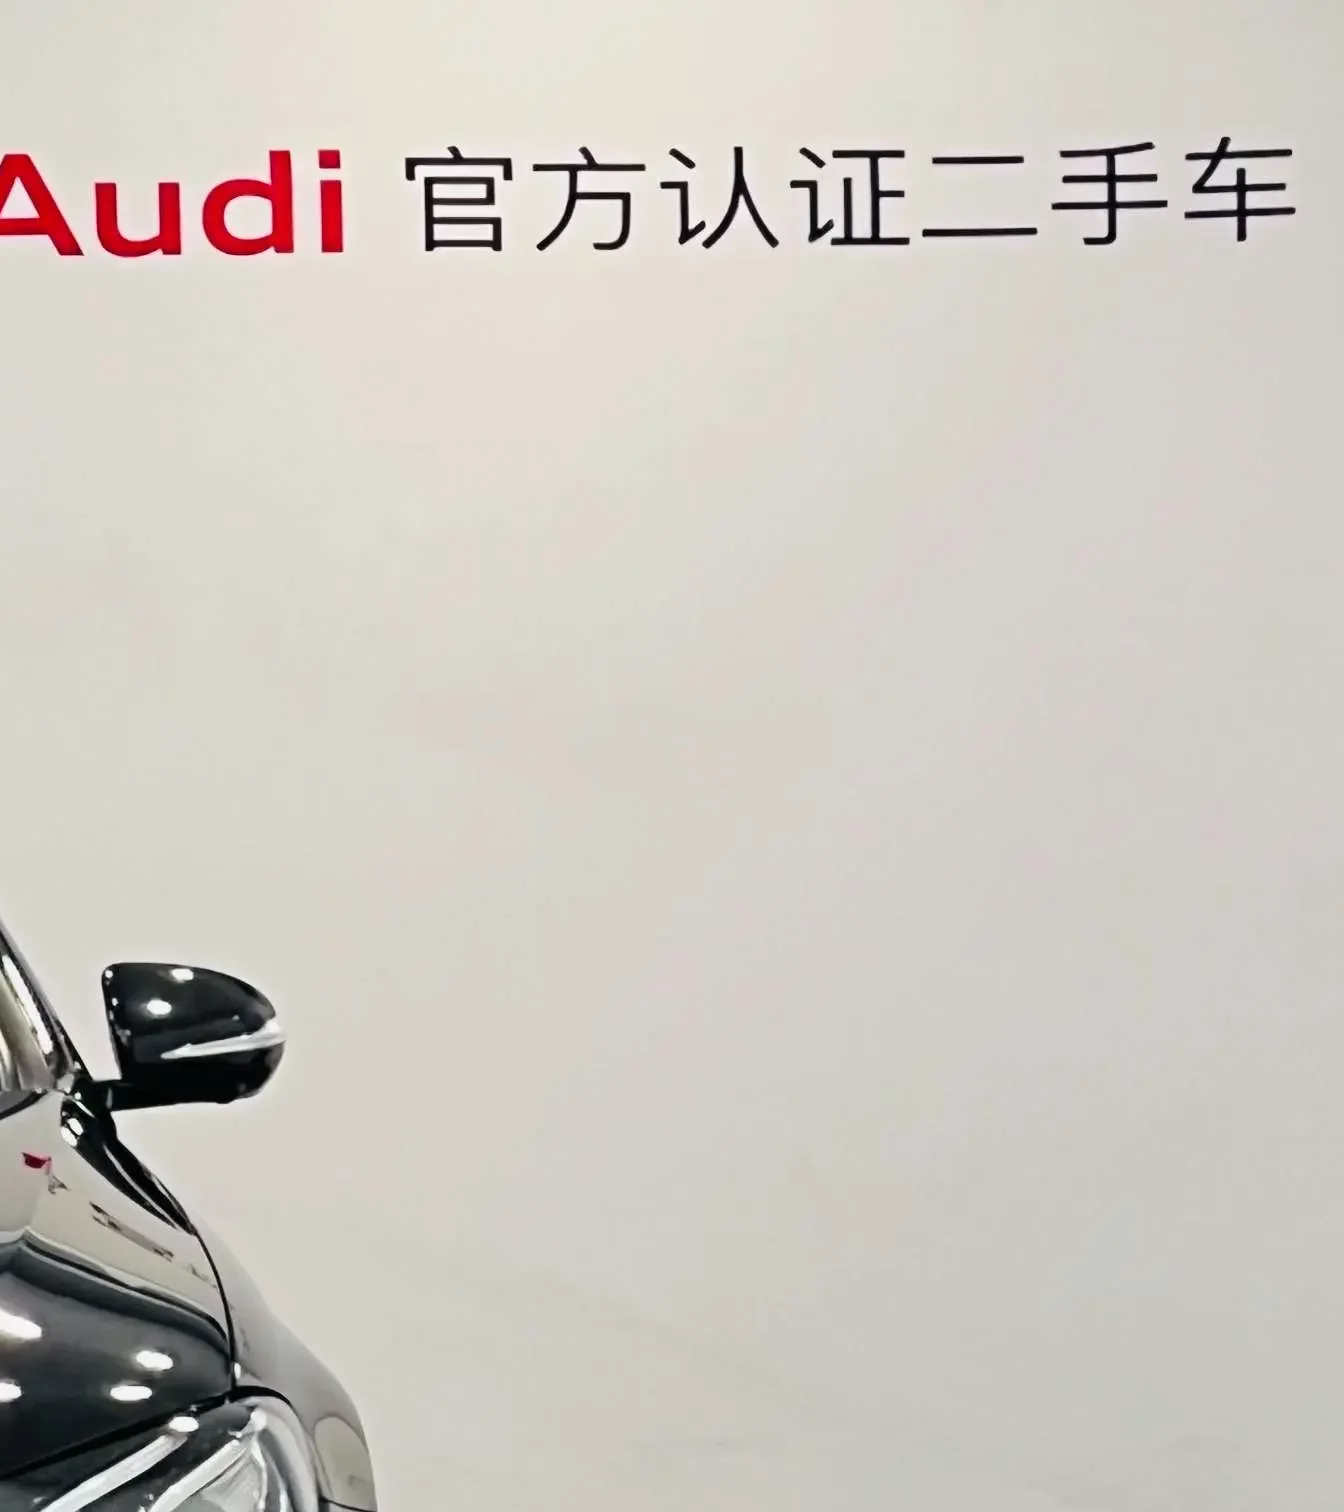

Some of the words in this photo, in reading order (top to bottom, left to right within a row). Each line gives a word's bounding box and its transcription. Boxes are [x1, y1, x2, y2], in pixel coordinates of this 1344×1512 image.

[405, 135, 1298, 253] 官方认证二手车
